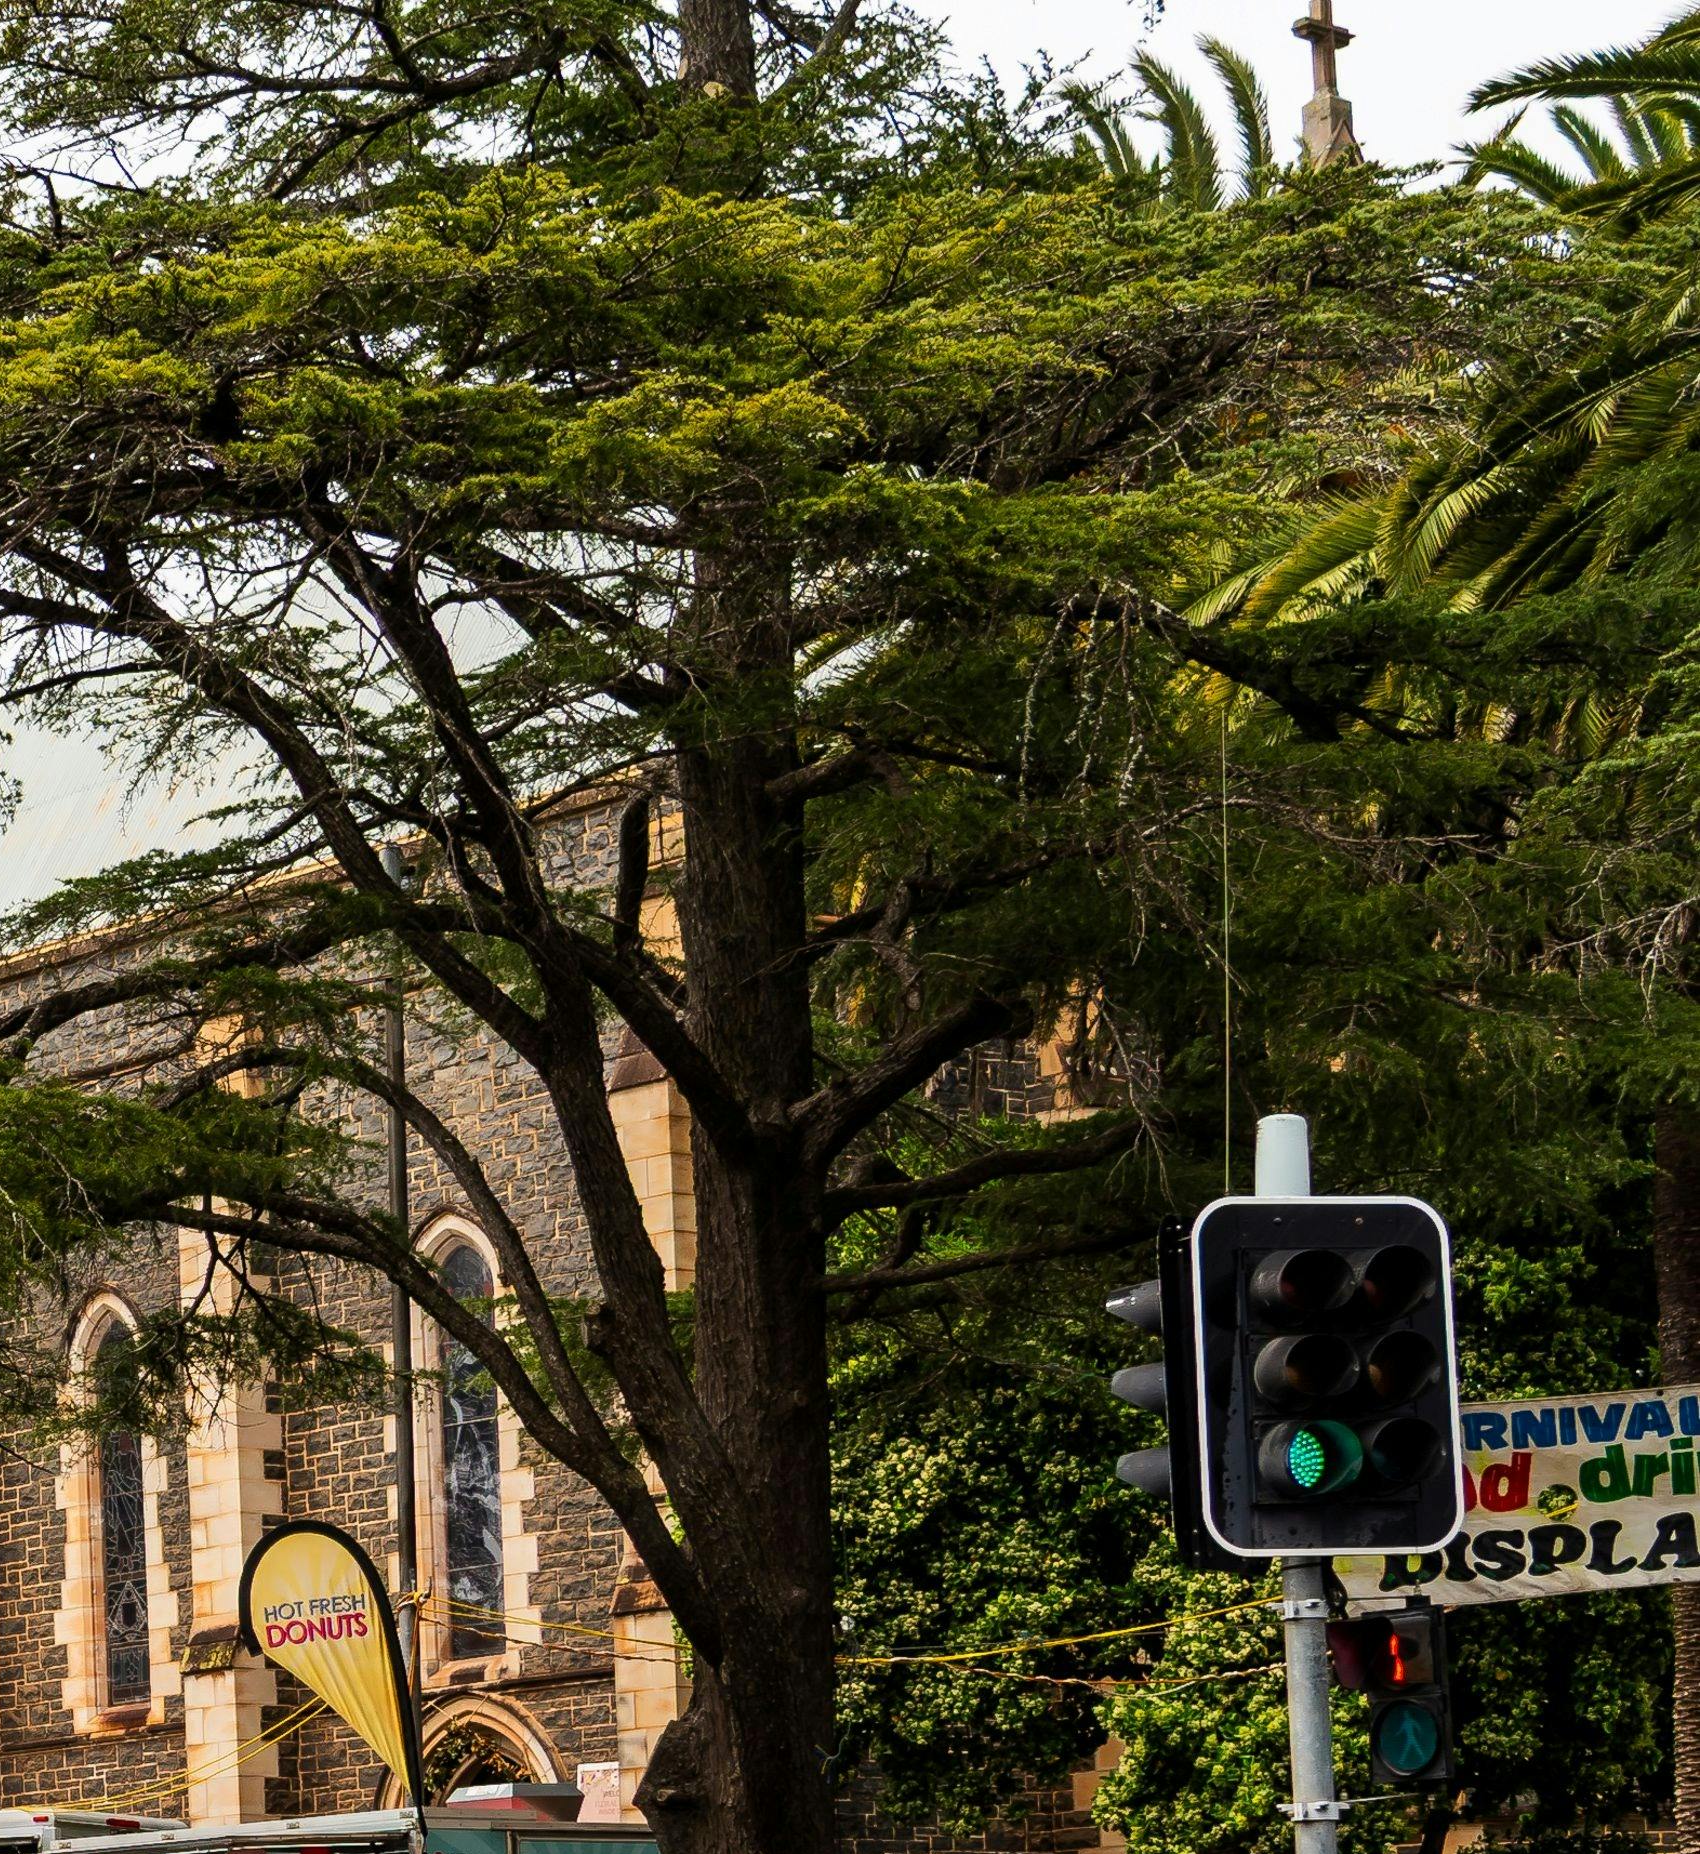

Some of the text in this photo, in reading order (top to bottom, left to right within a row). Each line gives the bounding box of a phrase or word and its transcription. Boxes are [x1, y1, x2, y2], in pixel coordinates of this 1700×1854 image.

[1459, 1395, 1700, 1451] RNIVAL
[1579, 1437, 1700, 1504] dri
[264, 1594, 366, 1622] HOT FRESH
[265, 1612, 368, 1648] DONUTS
